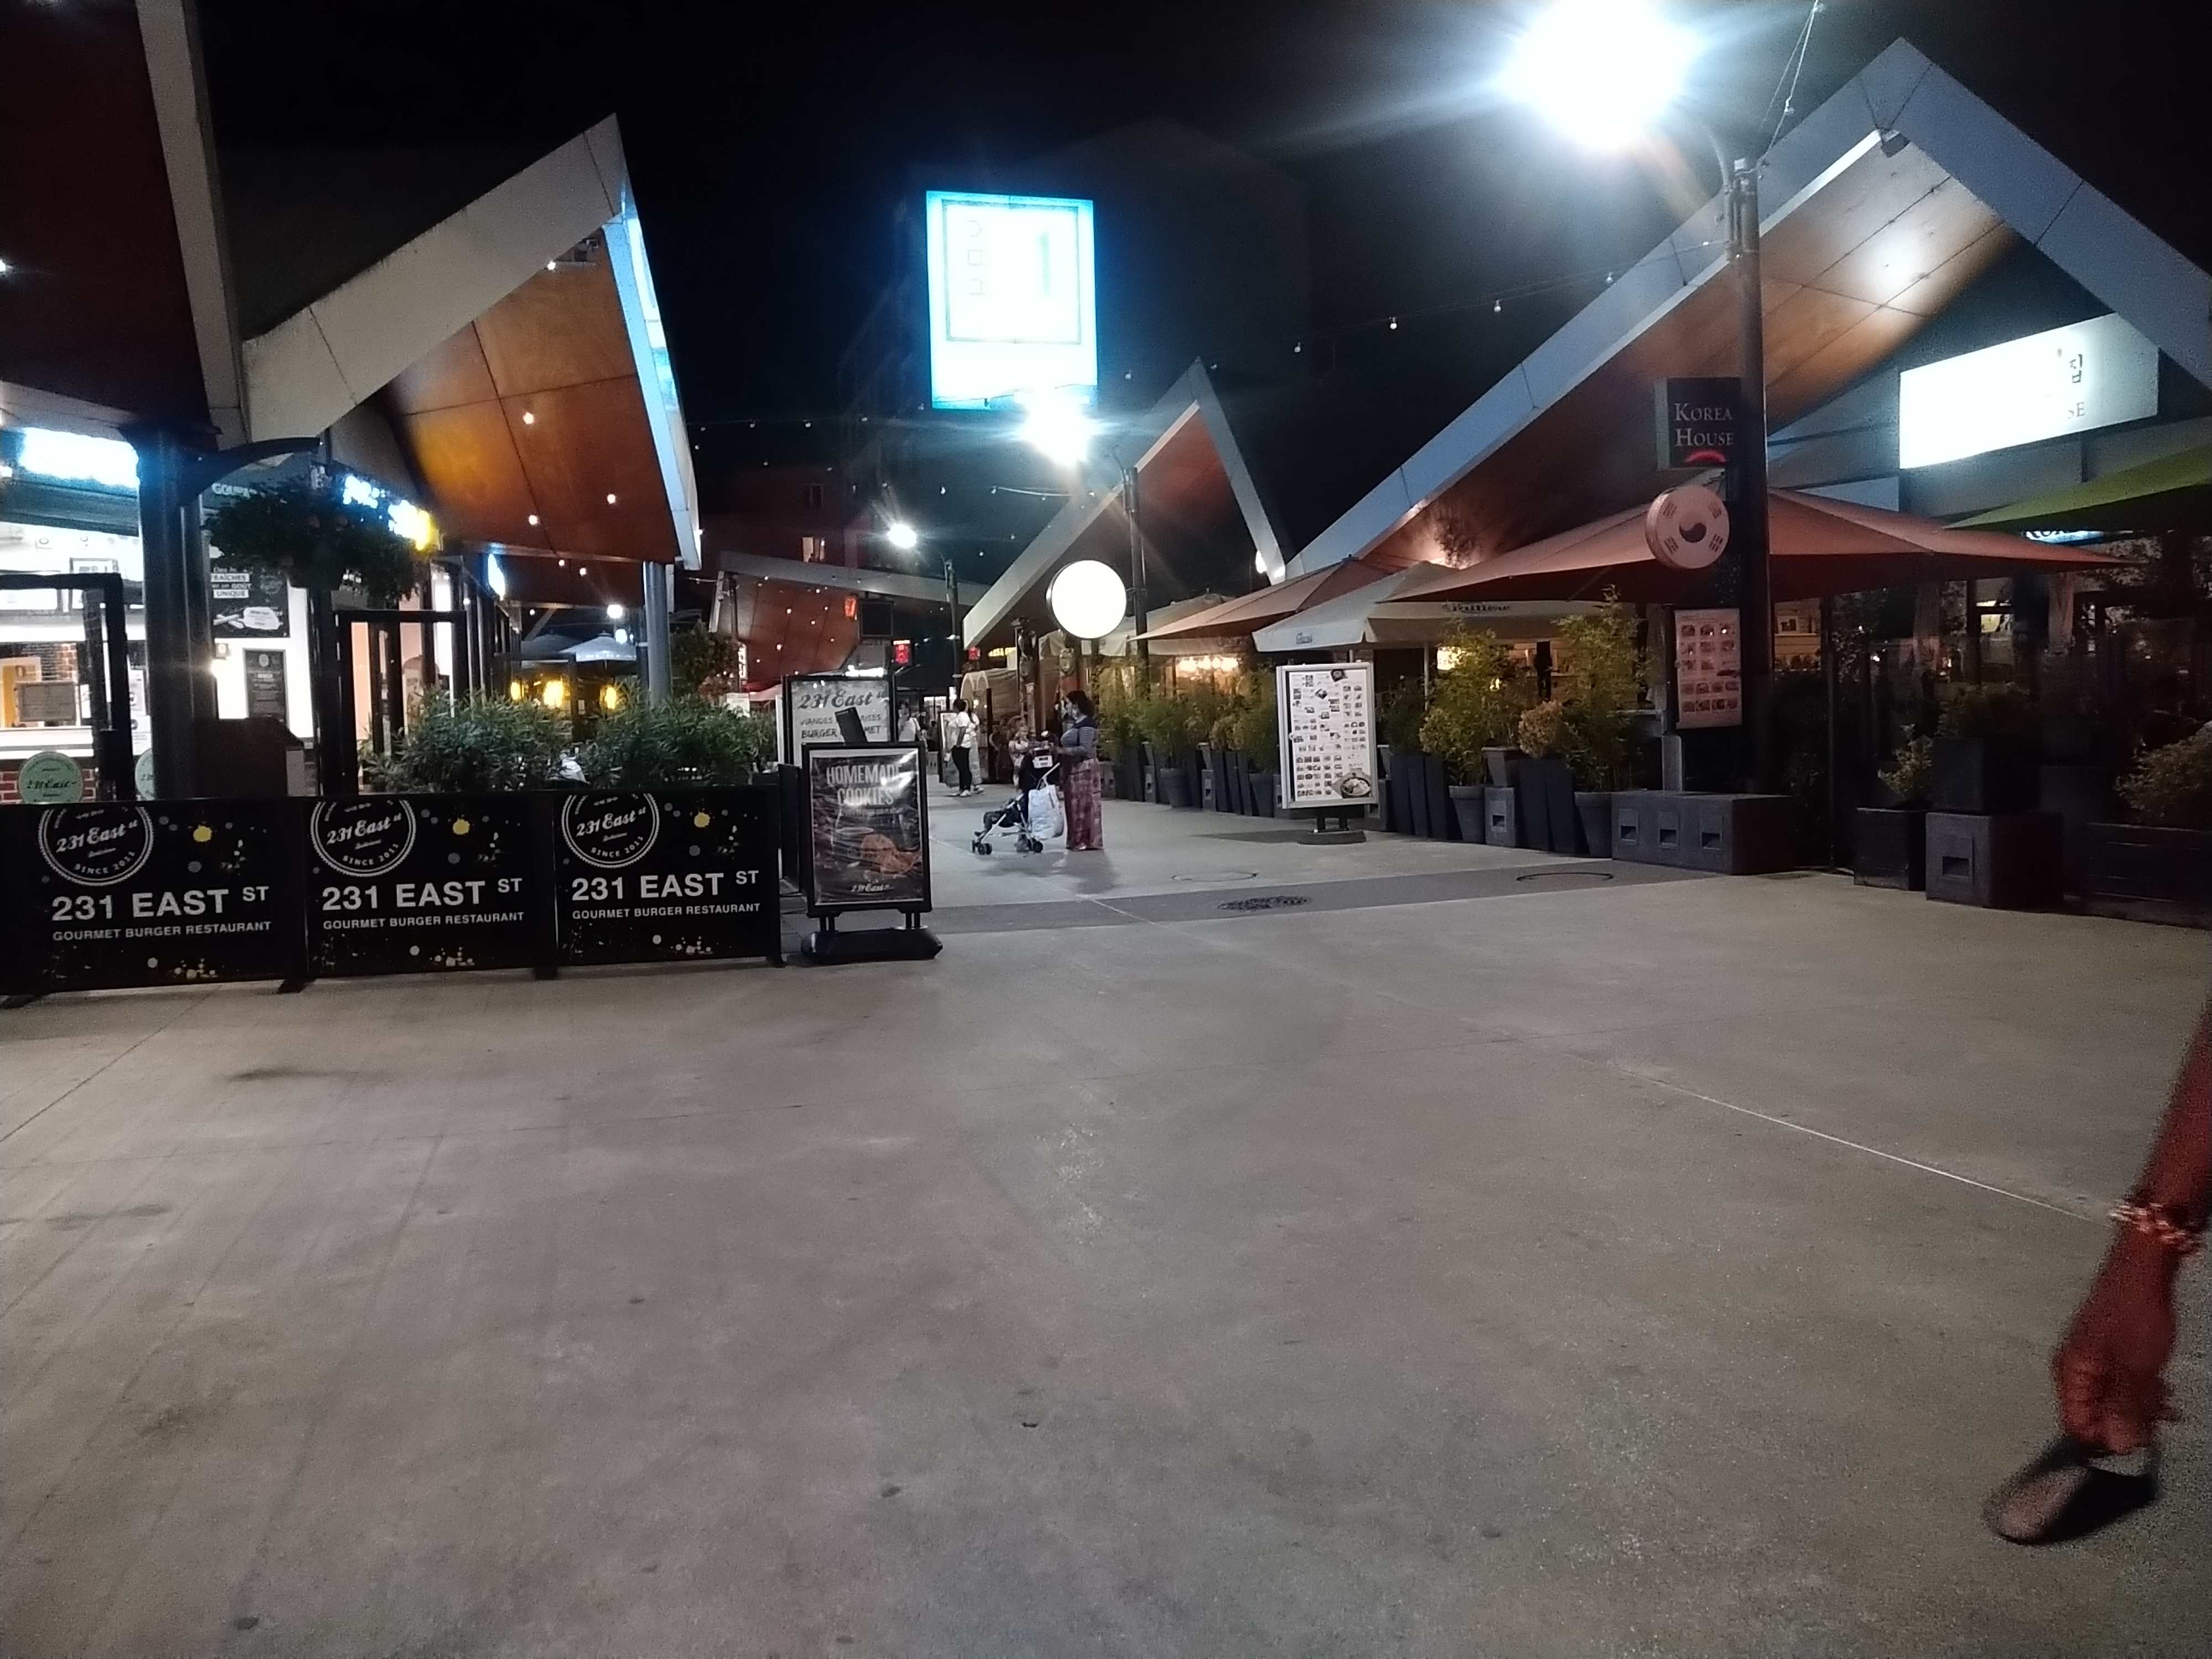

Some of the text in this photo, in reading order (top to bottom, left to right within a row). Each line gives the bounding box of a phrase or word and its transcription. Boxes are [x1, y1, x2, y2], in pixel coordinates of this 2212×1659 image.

[1673, 402, 1734, 421] KOREA
[1674, 427, 1734, 447] HOUSE
[797, 693, 830, 709] 231
[831, 690, 873, 708] East
[801, 728, 838, 739] BURGER
[326, 826, 353, 846] 231
[354, 816, 392, 837] East
[575, 818, 601, 838] 231
[602, 810, 637, 830] East
[56, 833, 85, 853] 231
[86, 823, 126, 845] East
[591, 847, 620, 858] SINCE
[624, 836, 644, 854] 2011
[74, 863, 109, 874] SINCE
[112, 851, 135, 870] 2011
[342, 855, 374, 866] SINCE
[378, 843, 399, 862] 2011
[321, 878, 523, 911] 231 EAST ST
[571, 870, 759, 901] 231 EAST ST
[51, 886, 269, 921] 231 EAST ST
[572, 902, 761, 920] GOURMET BURGER RESTAURANT
[53, 921, 272, 942] GOURMET BURGER RESTAURANT
[322, 911, 525, 930] GOURMET BURGER RESTAURANT
